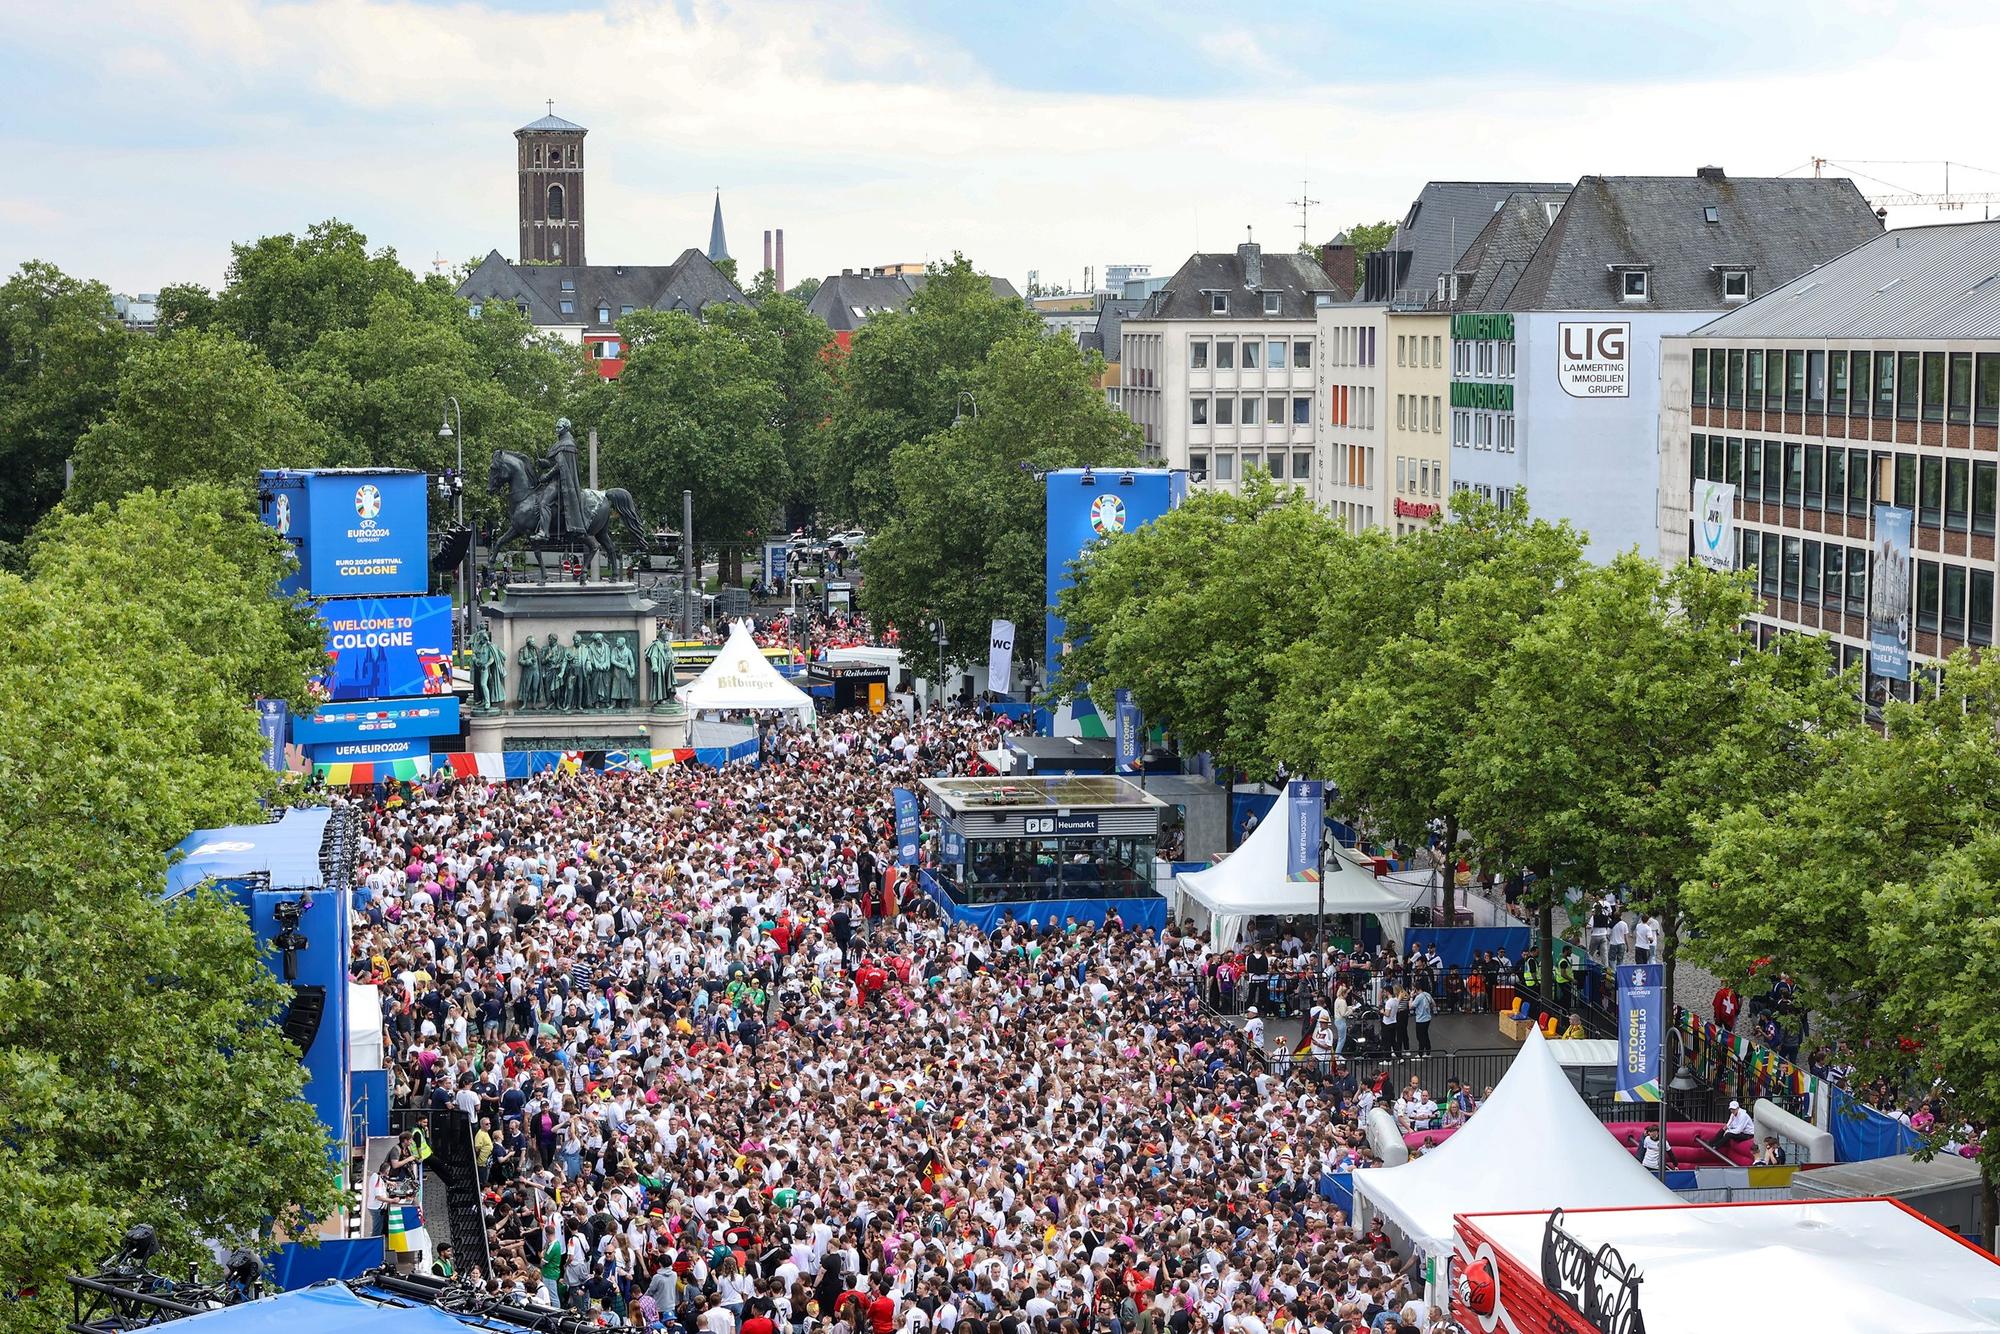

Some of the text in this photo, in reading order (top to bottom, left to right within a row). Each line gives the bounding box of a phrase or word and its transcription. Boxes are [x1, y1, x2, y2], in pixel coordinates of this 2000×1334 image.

[1451, 313, 1515, 340] LAMMERTING
[1563, 328, 1625, 361] LIG
[1563, 363, 1625, 373] LAMMERTING
[1571, 374, 1625, 383] IMMOBILIEN
[1587, 385, 1625, 395] GRUPPE
[1450, 382, 1514, 411] IMMOBILIEN
[347, 528, 390, 539] EURO2024
[335, 559, 353, 567] EURO
[340, 565, 398, 576] COLOGNE
[333, 618, 413, 631] WELCOME TO
[333, 631, 413, 649] COLOGNE
[992, 638, 1011, 651] WC
[843, 668, 889, 678] Reibekuchen
[717, 674, 774, 690] Bitburger
[336, 743, 409, 756] UEFAEURO2024
[1058, 820, 1095, 830] Heumarkt
[674, 954, 681, 965] 9
